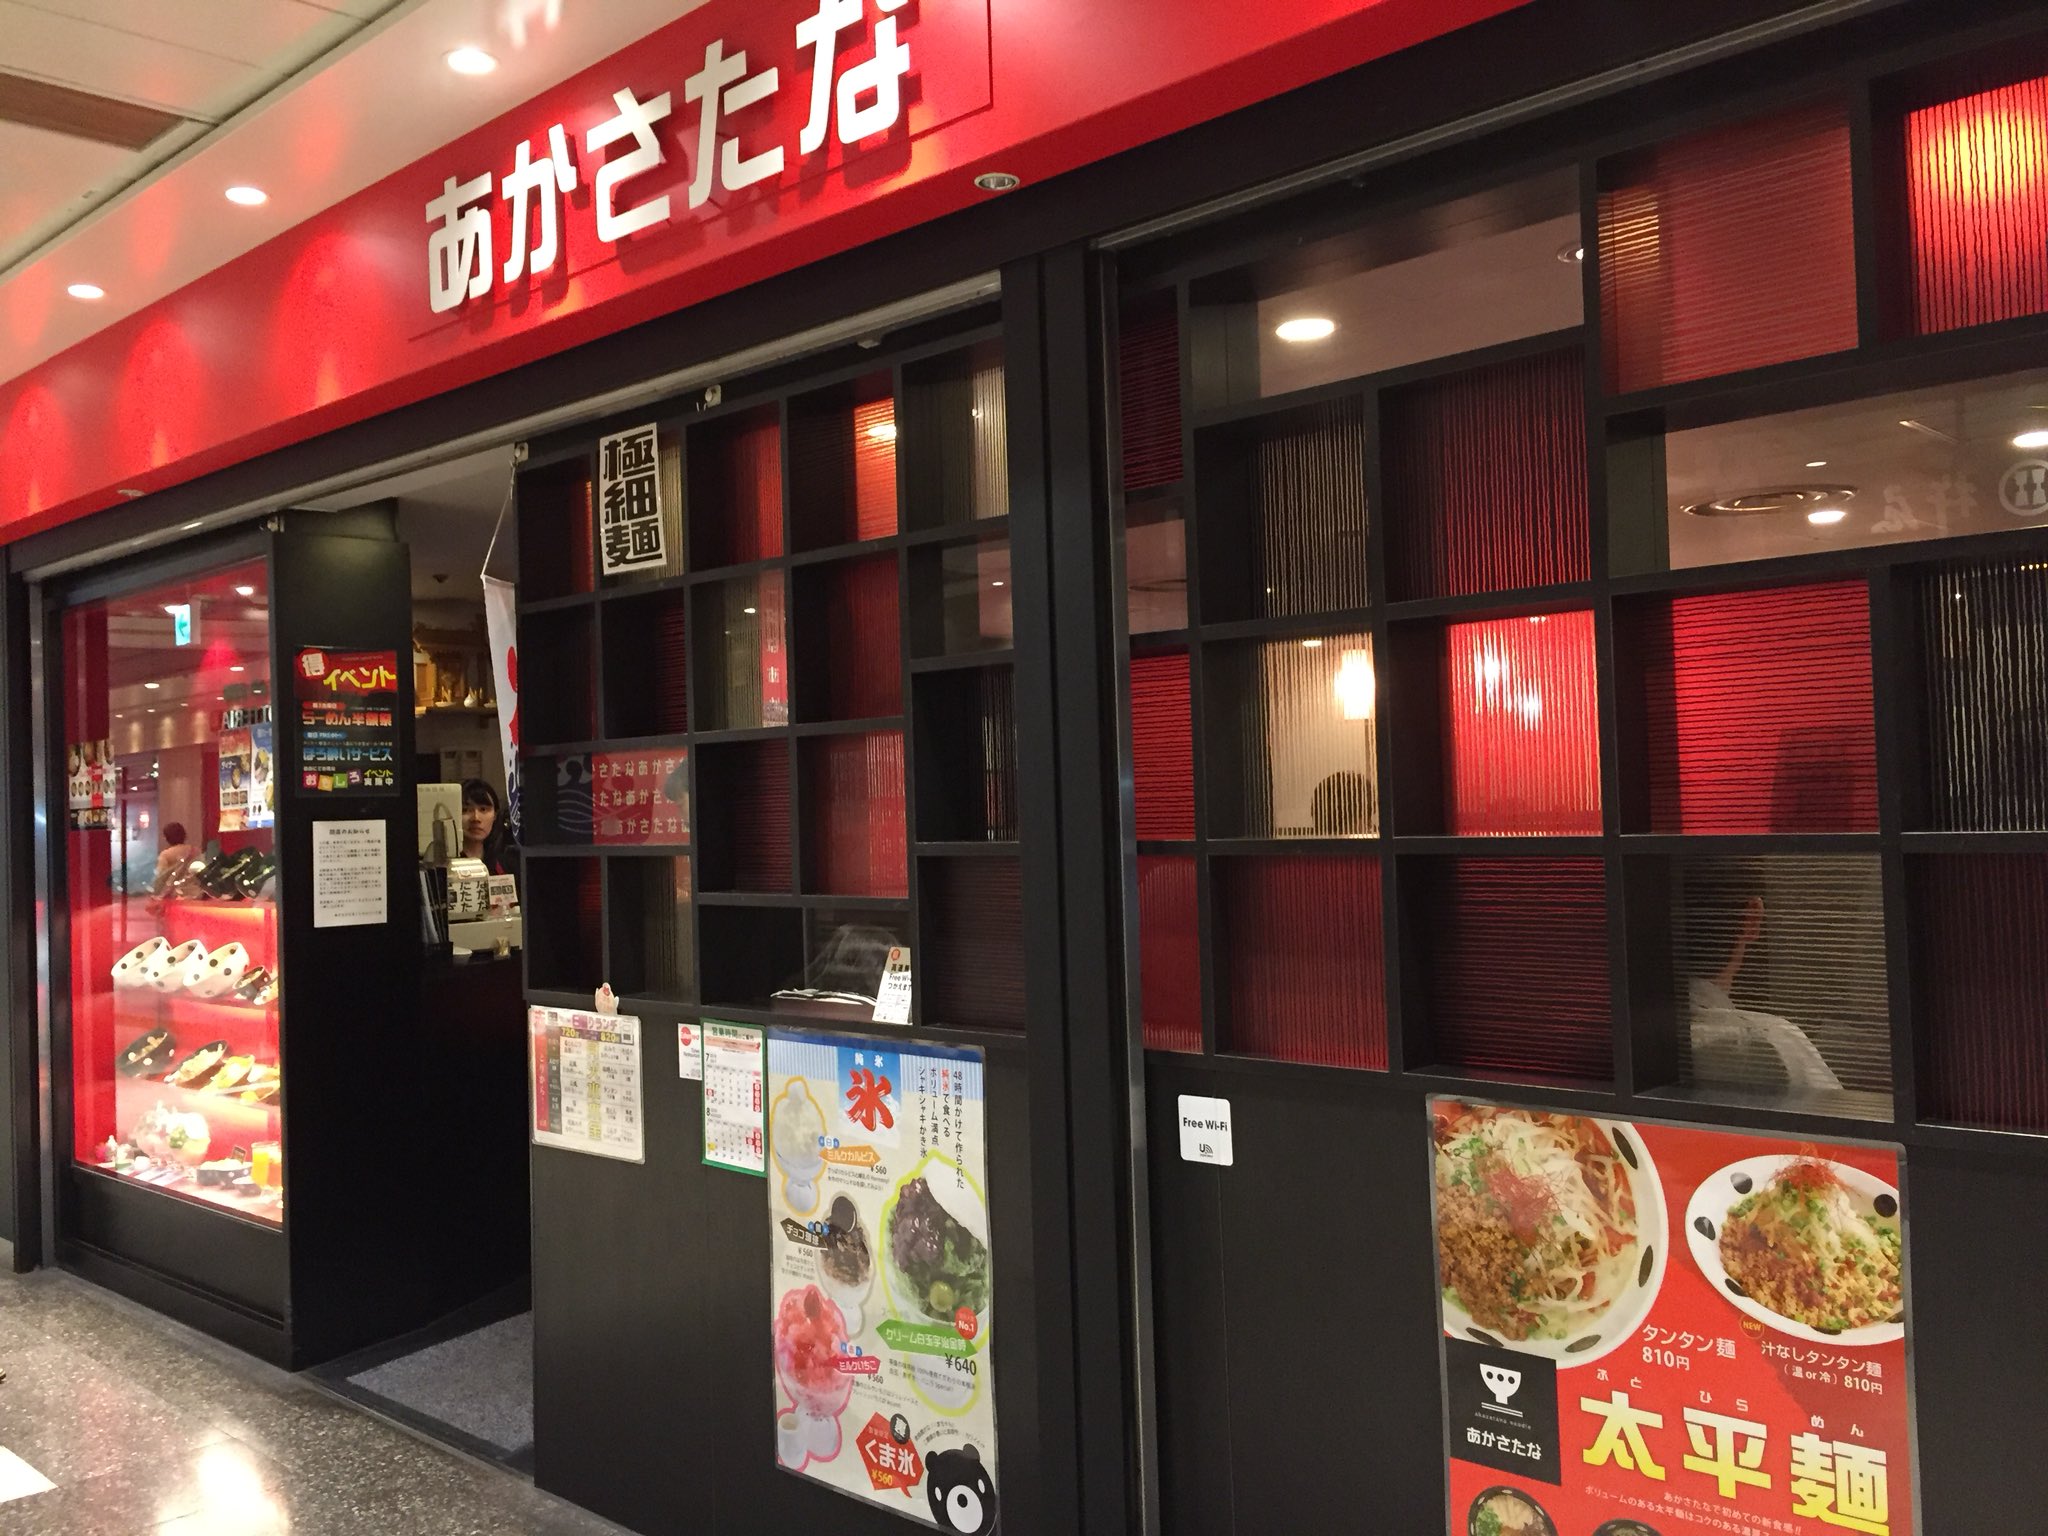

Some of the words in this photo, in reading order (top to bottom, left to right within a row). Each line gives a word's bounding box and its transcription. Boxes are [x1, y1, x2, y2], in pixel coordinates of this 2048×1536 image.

[426, 0, 911, 314] あかさたな
[603, 429, 663, 568] 極細麺
[323, 665, 397, 691] イベント
[845, 1068, 895, 1132] 氷
[1183, 1117, 1203, 1128] Free
[1205, 1120, 1228, 1131] Wi-Fi
[958, 1320, 975, 1332] No.1
[1743, 1321, 1762, 1332] NEW
[1642, 1324, 1737, 1359] タンタン麺
[944, 1353, 977, 1376] ¥640
[1642, 1346, 1691, 1371] 810円
[1761, 1340, 1883, 1378] 汁なしタンタン麺
[1843, 1375, 1883, 1395] 810円
[1466, 1426, 1542, 1460] あかさたな
[864, 1439, 916, 1478] くま氷
[1580, 1390, 1890, 1535] 太平麺
[871, 1469, 893, 1486] ¥560
